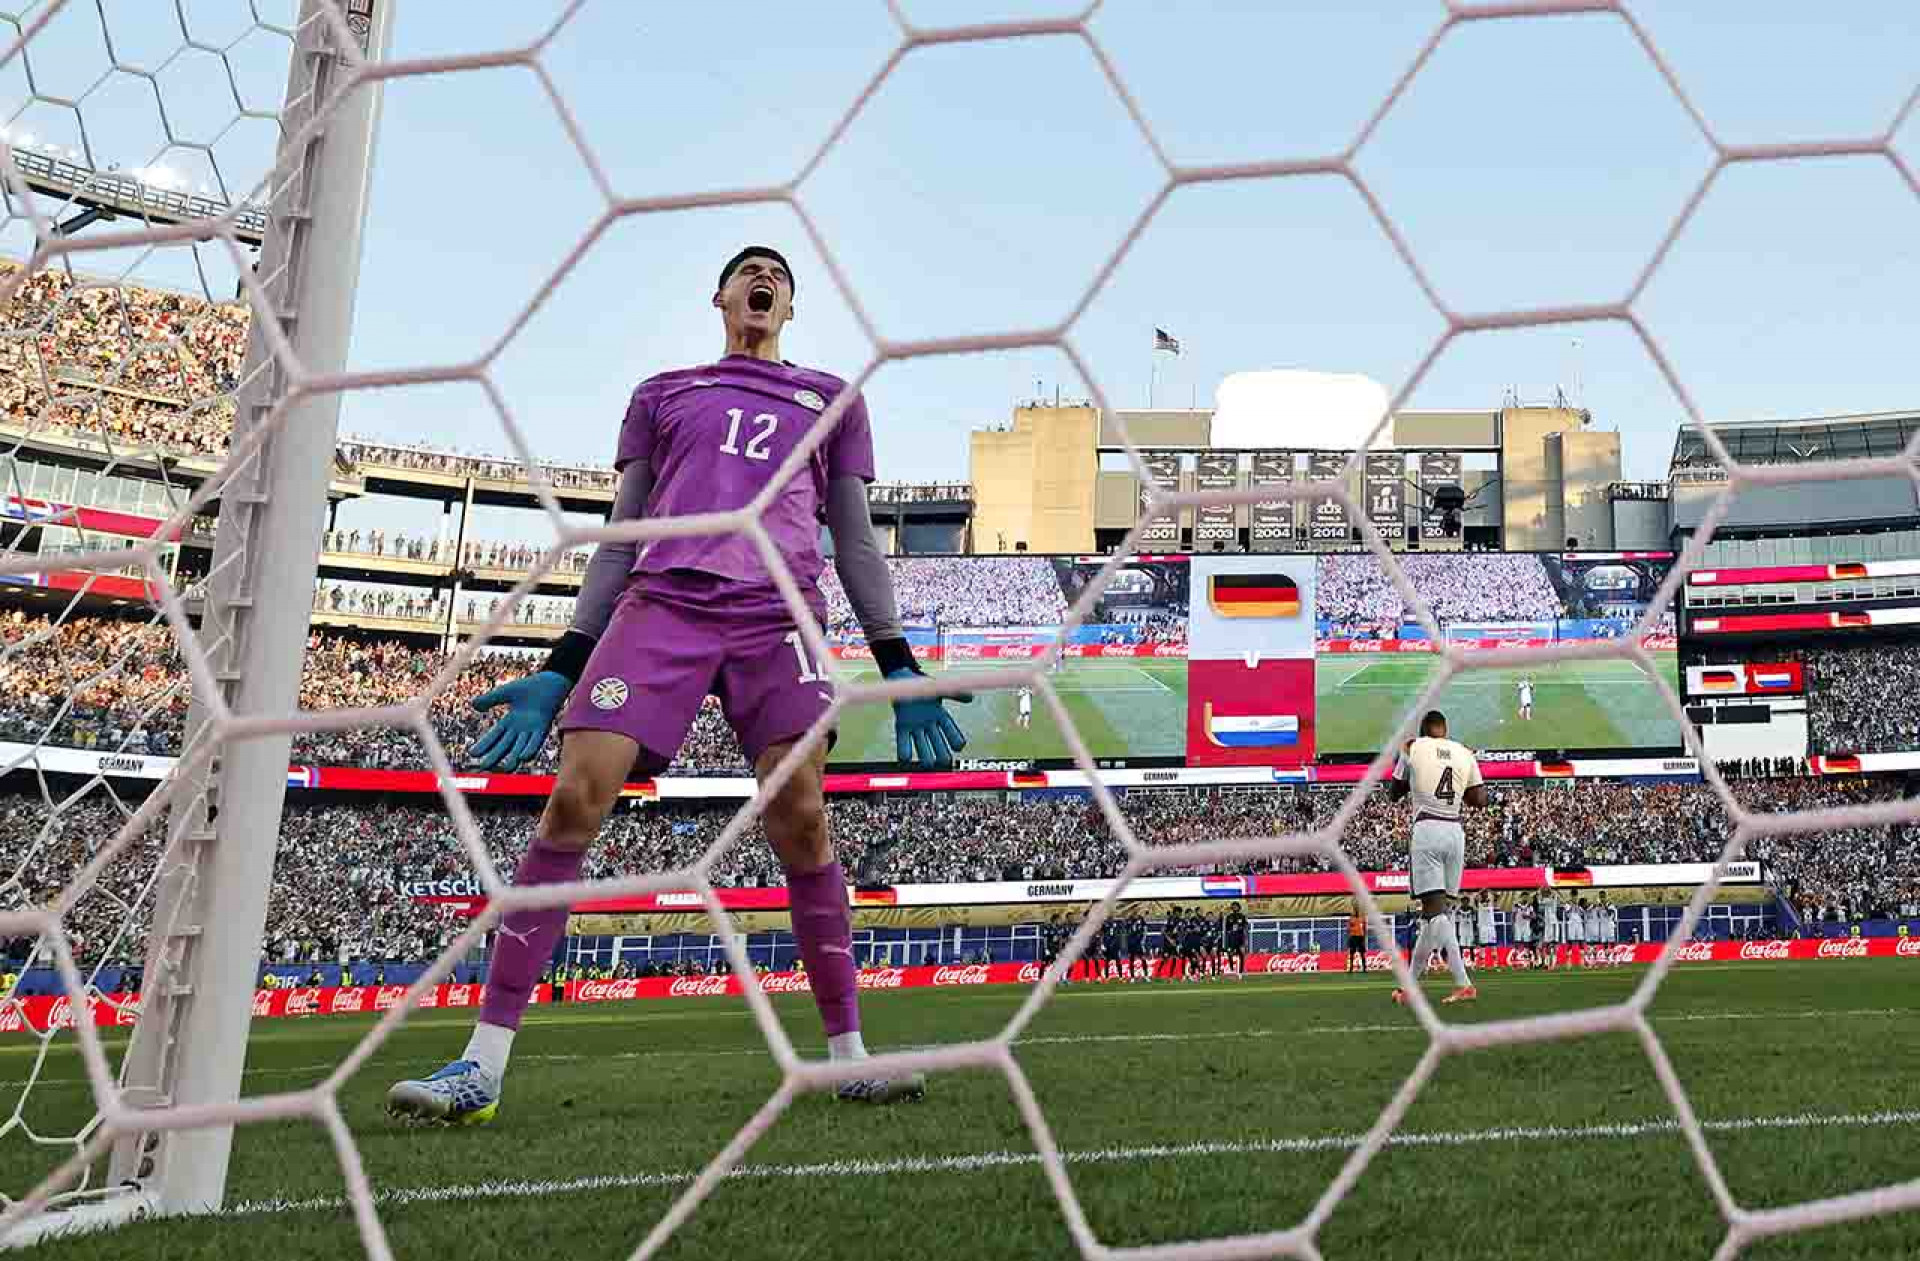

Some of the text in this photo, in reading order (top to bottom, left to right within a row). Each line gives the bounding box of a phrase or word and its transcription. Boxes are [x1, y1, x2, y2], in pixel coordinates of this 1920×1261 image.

[719, 407, 778, 460] 12
[1141, 528, 1176, 539] 2001
[1197, 528, 1234, 539] 2003
[1254, 528, 1291, 539] 2004
[1312, 527, 1345, 538] 2014
[98, 756, 145, 773] GERMANY
[959, 759, 1029, 771] Hisense
[1143, 771, 1179, 781] GERMANY
[1434, 766, 1456, 805] 4
[400, 879, 481, 897] KETSCH
[1027, 884, 1074, 898] GERMANY
